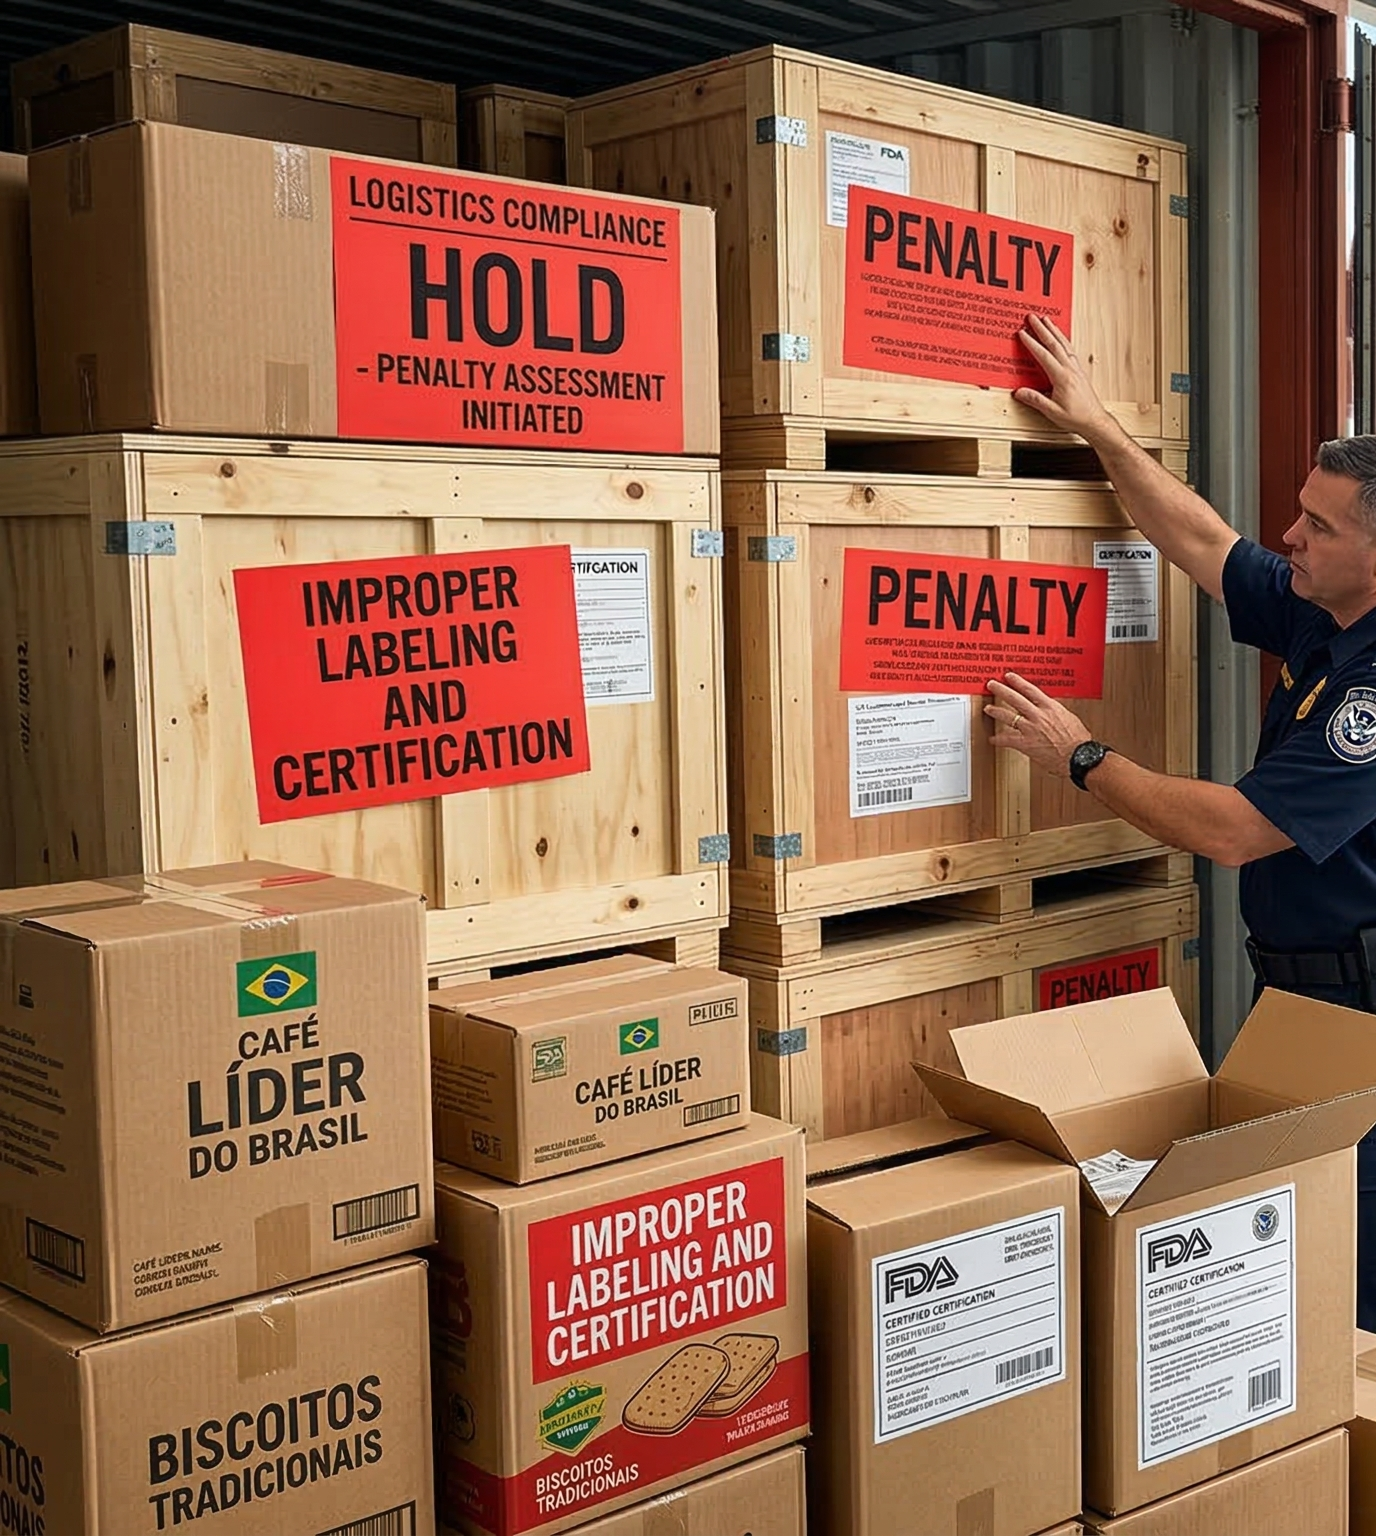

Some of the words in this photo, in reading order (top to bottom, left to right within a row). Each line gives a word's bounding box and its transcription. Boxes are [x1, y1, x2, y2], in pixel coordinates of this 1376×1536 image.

[880, 147, 905, 161] FDA
[349, 174, 496, 225] LOGISTICS
[503, 198, 667, 248] COMPLIANCE
[865, 205, 1061, 297] PENALTY
[409, 243, 625, 355] HOLD
[377, 353, 496, 392] PENALTY
[503, 362, 666, 403] ASSESSMENT
[461, 398, 584, 435] INITIATED
[302, 565, 520, 626] IMPROPER
[868, 565, 1087, 637] PENALTY
[316, 619, 517, 682] LABELING
[384, 680, 466, 731] AND
[272, 718, 573, 801] CERTIFICATION
[1051, 961, 1150, 1008] PENALTY
[239, 1013, 321, 1060] CAFÉ
[188, 1052, 367, 1137] LÍDER
[575, 1067, 633, 1105] CAFÉ
[639, 1057, 702, 1091] LÍDER
[595, 1103, 620, 1124] DO
[624, 1087, 684, 1117] BRASIL
[189, 1140, 238, 1179] DO
[249, 1112, 368, 1167] BRASIL
[571, 1180, 747, 1266] IMPROPER
[1148, 1227, 1212, 1274] FDA
[548, 1241, 702, 1322] LABELING
[712, 1221, 773, 1273] AND
[885, 1255, 959, 1304] FDA
[548, 1262, 775, 1368] CERTIFICATION
[148, 1375, 383, 1485] BISCOITOS
[148, 1429, 383, 1530] TRADICIONAIS
[535, 1453, 614, 1496] BISCOITOS
[535, 1463, 639, 1515] TRADICIONAIS
